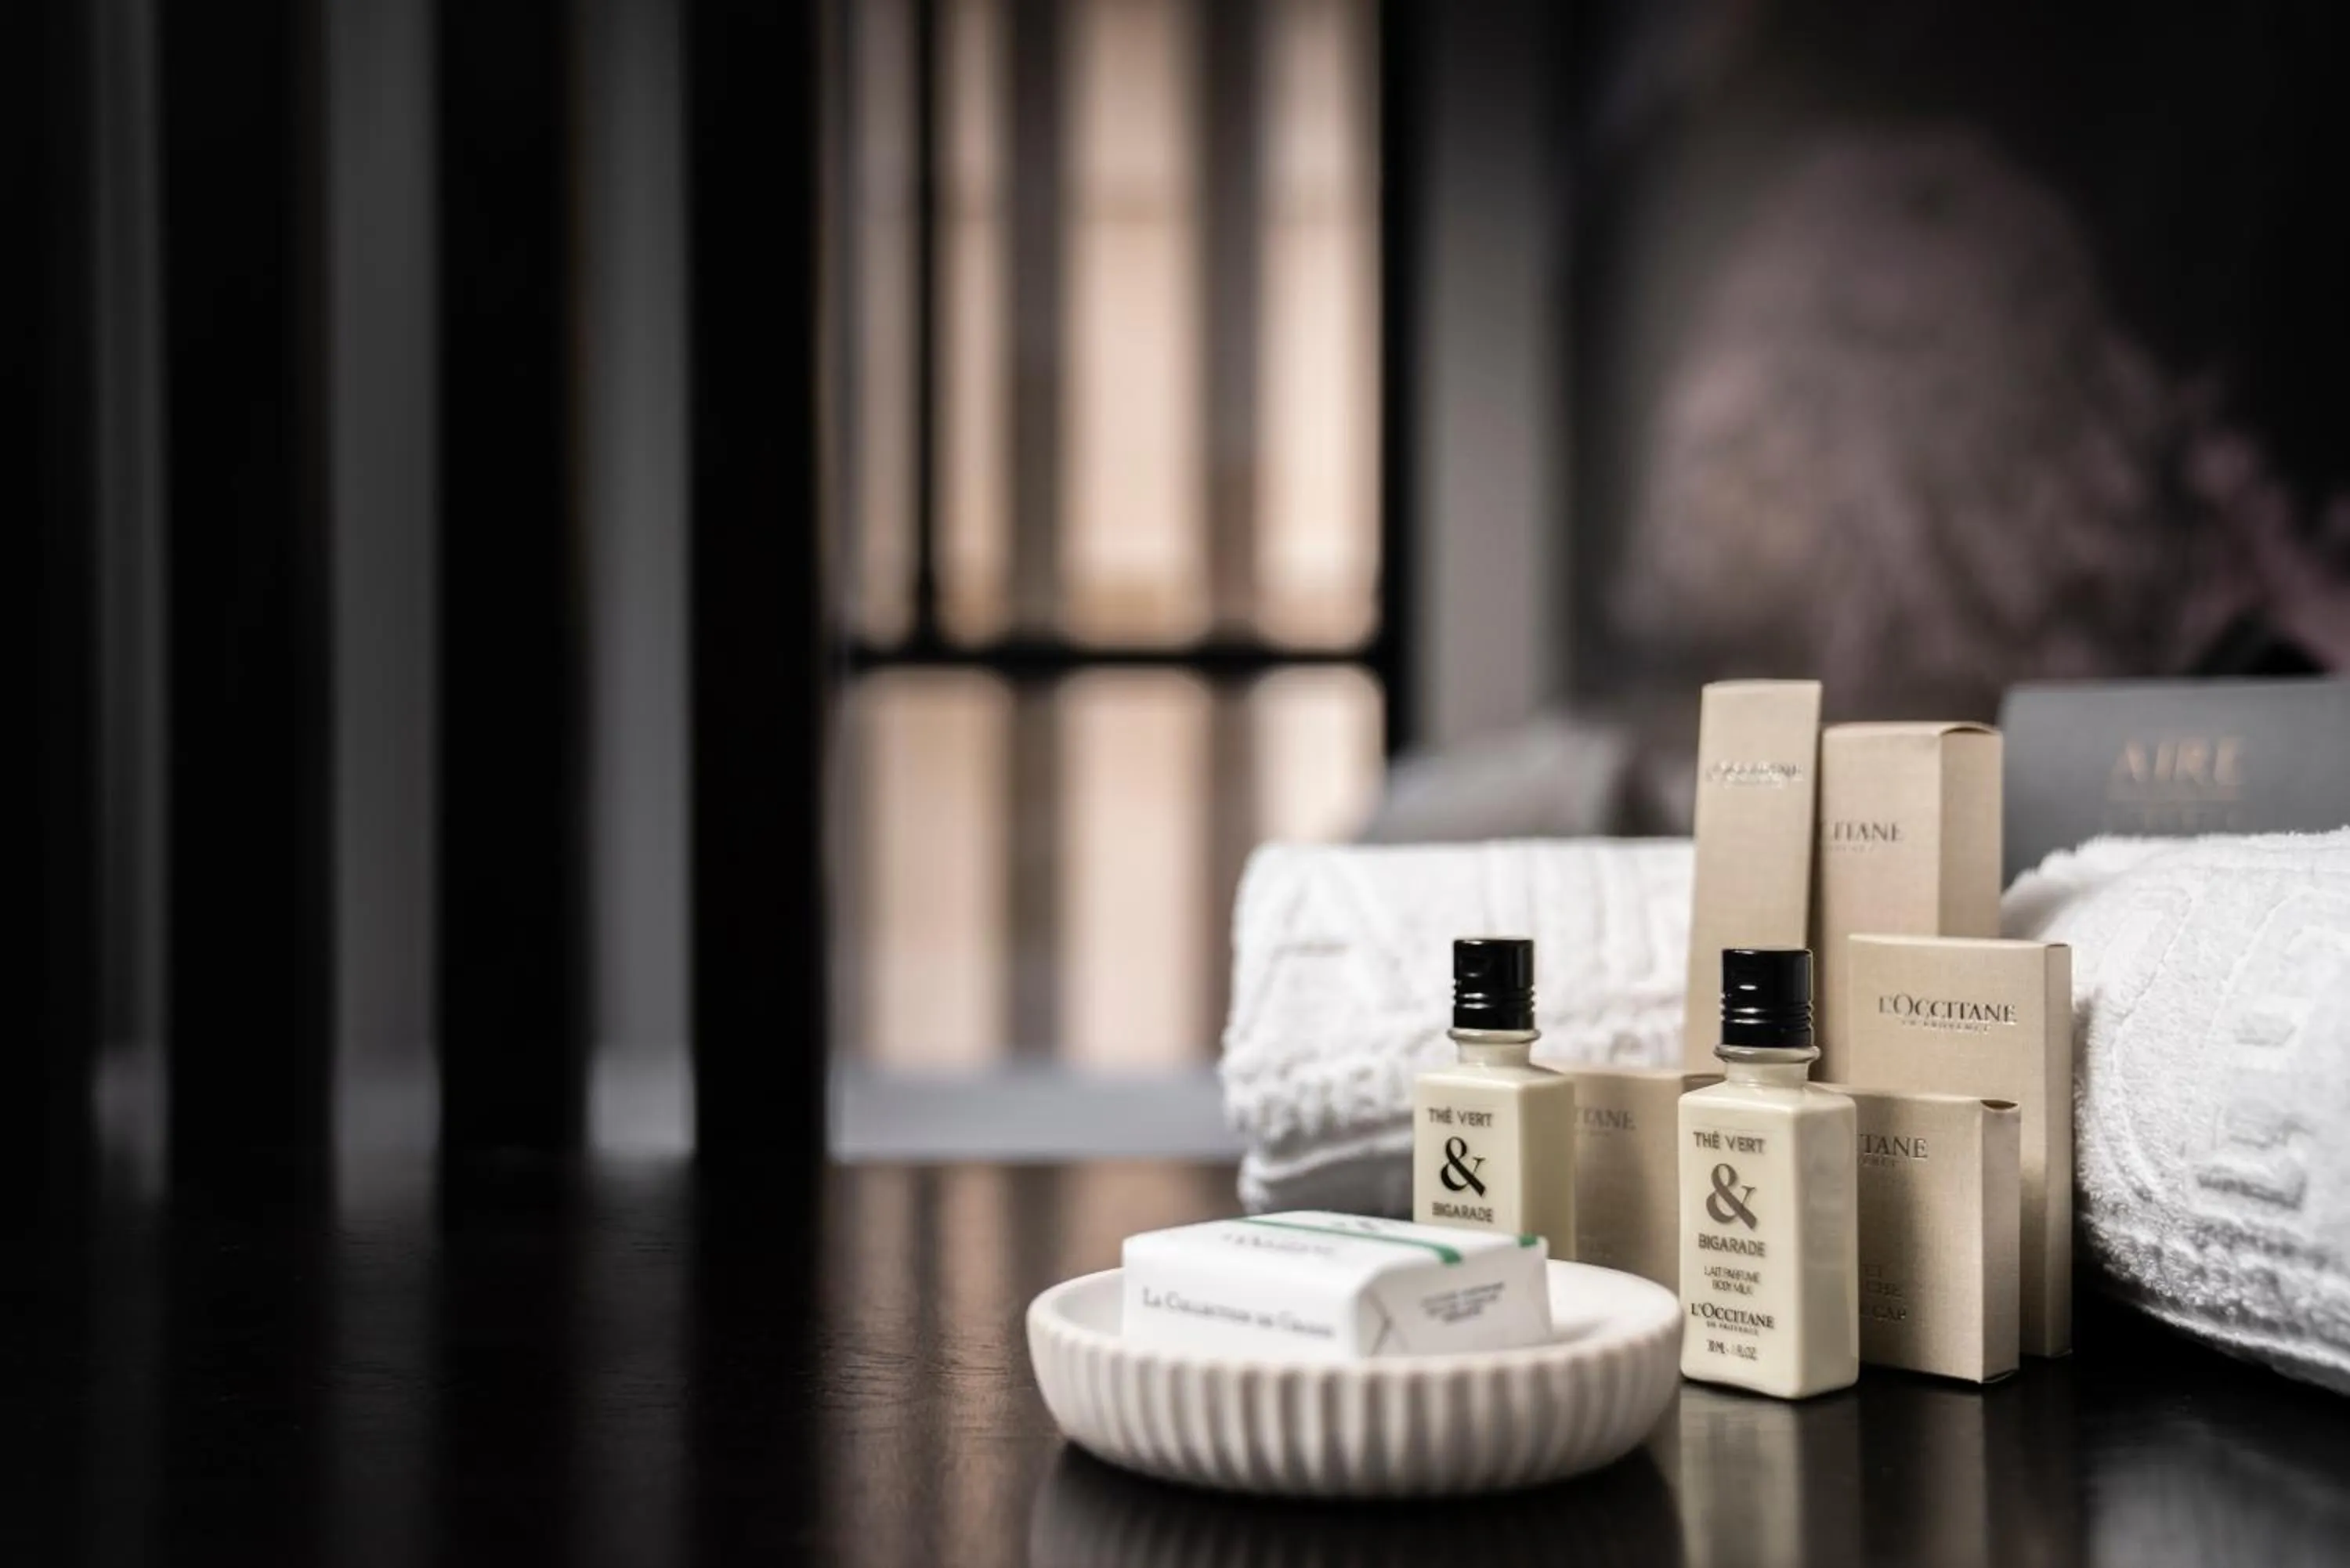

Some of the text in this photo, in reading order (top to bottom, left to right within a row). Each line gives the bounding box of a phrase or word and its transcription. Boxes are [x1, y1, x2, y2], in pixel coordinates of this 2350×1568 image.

[1878, 992, 2017, 1023] L'OCCITANE
[1457, 1111, 1492, 1128] VERT
[1726, 1136, 1766, 1154] VERT
[1440, 1136, 1486, 1198] &
[1705, 1162, 1758, 1231] &
[1432, 1201, 1493, 1223] BIGARADE
[1697, 1233, 1766, 1257] BIGARADE
[1690, 1302, 1775, 1330] L'OCCITANE
